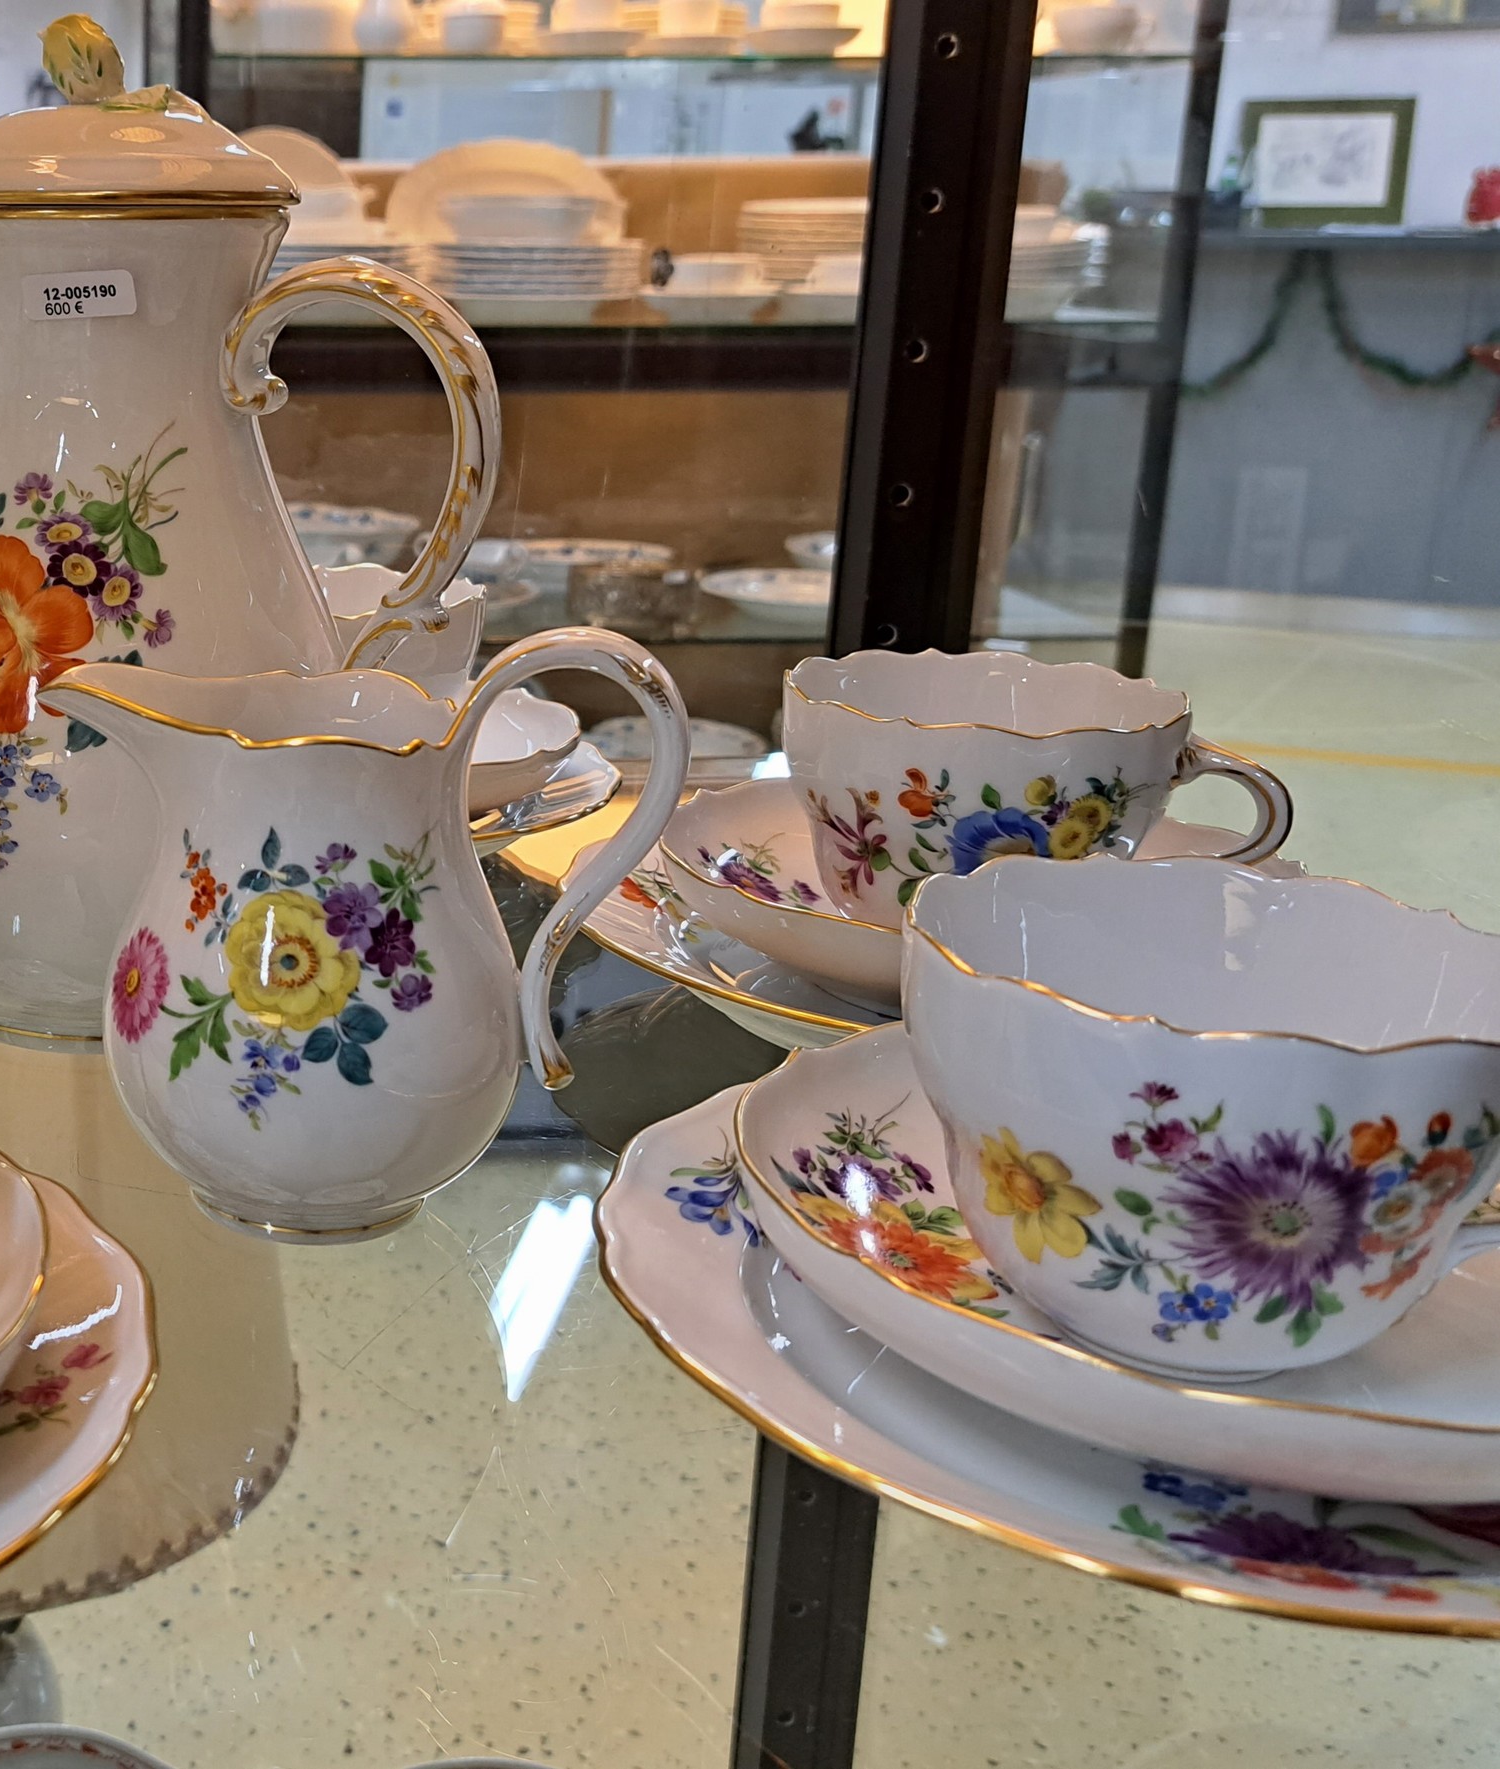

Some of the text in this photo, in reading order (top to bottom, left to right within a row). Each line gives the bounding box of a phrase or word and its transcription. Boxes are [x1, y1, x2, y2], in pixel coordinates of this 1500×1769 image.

[43, 284, 117, 301] 12-005190
[45, 300, 84, 315] 600 €
